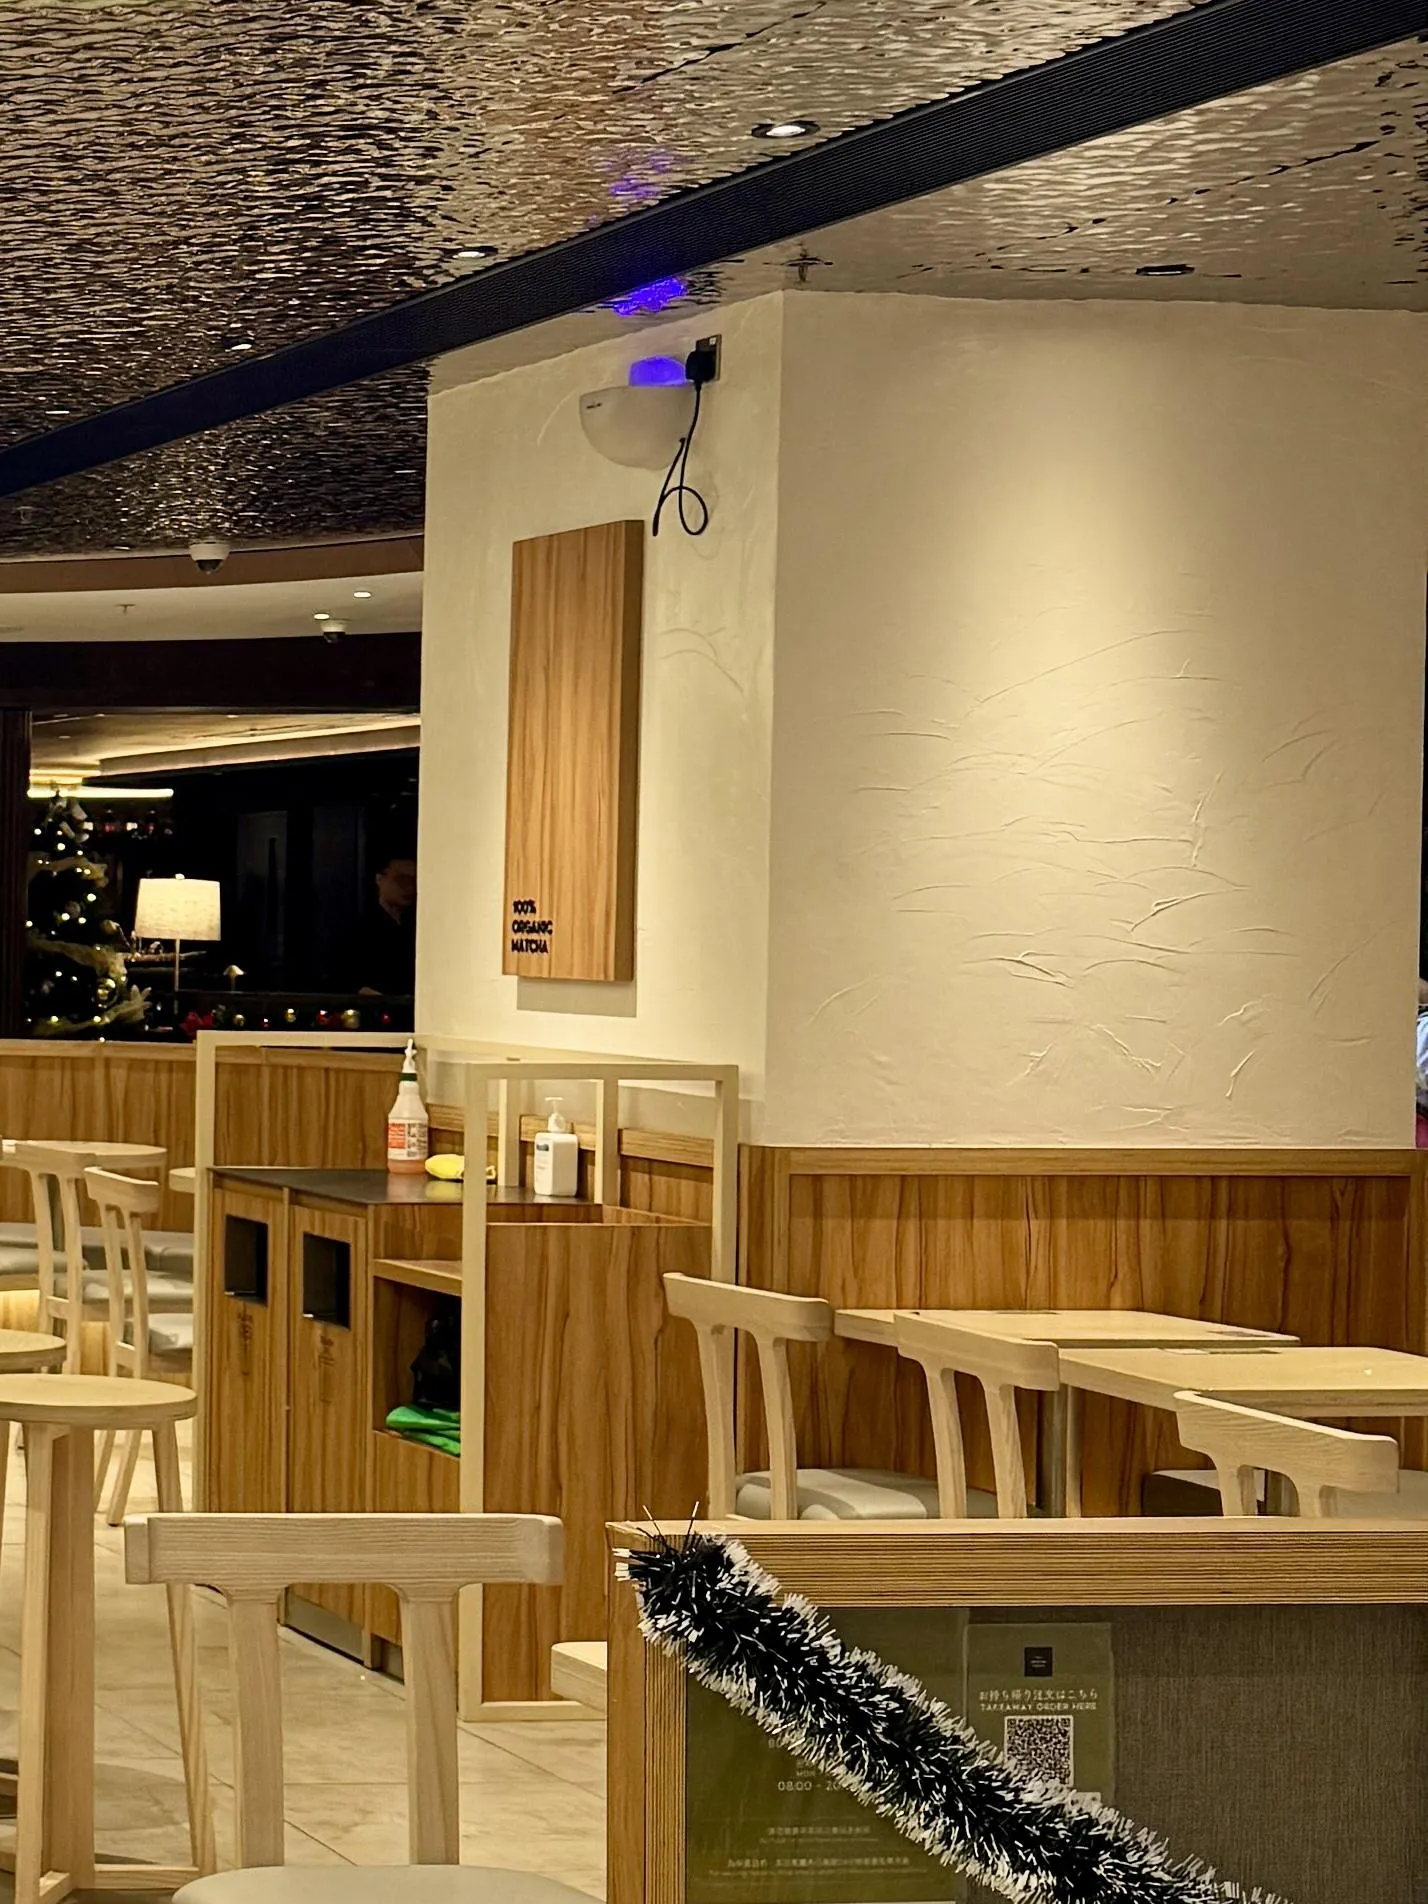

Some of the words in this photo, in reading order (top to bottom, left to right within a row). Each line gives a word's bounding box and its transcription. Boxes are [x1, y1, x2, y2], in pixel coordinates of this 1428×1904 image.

[512, 899, 537, 915] 100%
[511, 919, 554, 935] ORGANIC
[511, 938, 549, 954] MATCHA
[980, 1702, 1033, 1711] TAKEAWAY
[1036, 1702, 1070, 1711] ORDER
[1072, 1702, 1097, 1711] HERE
